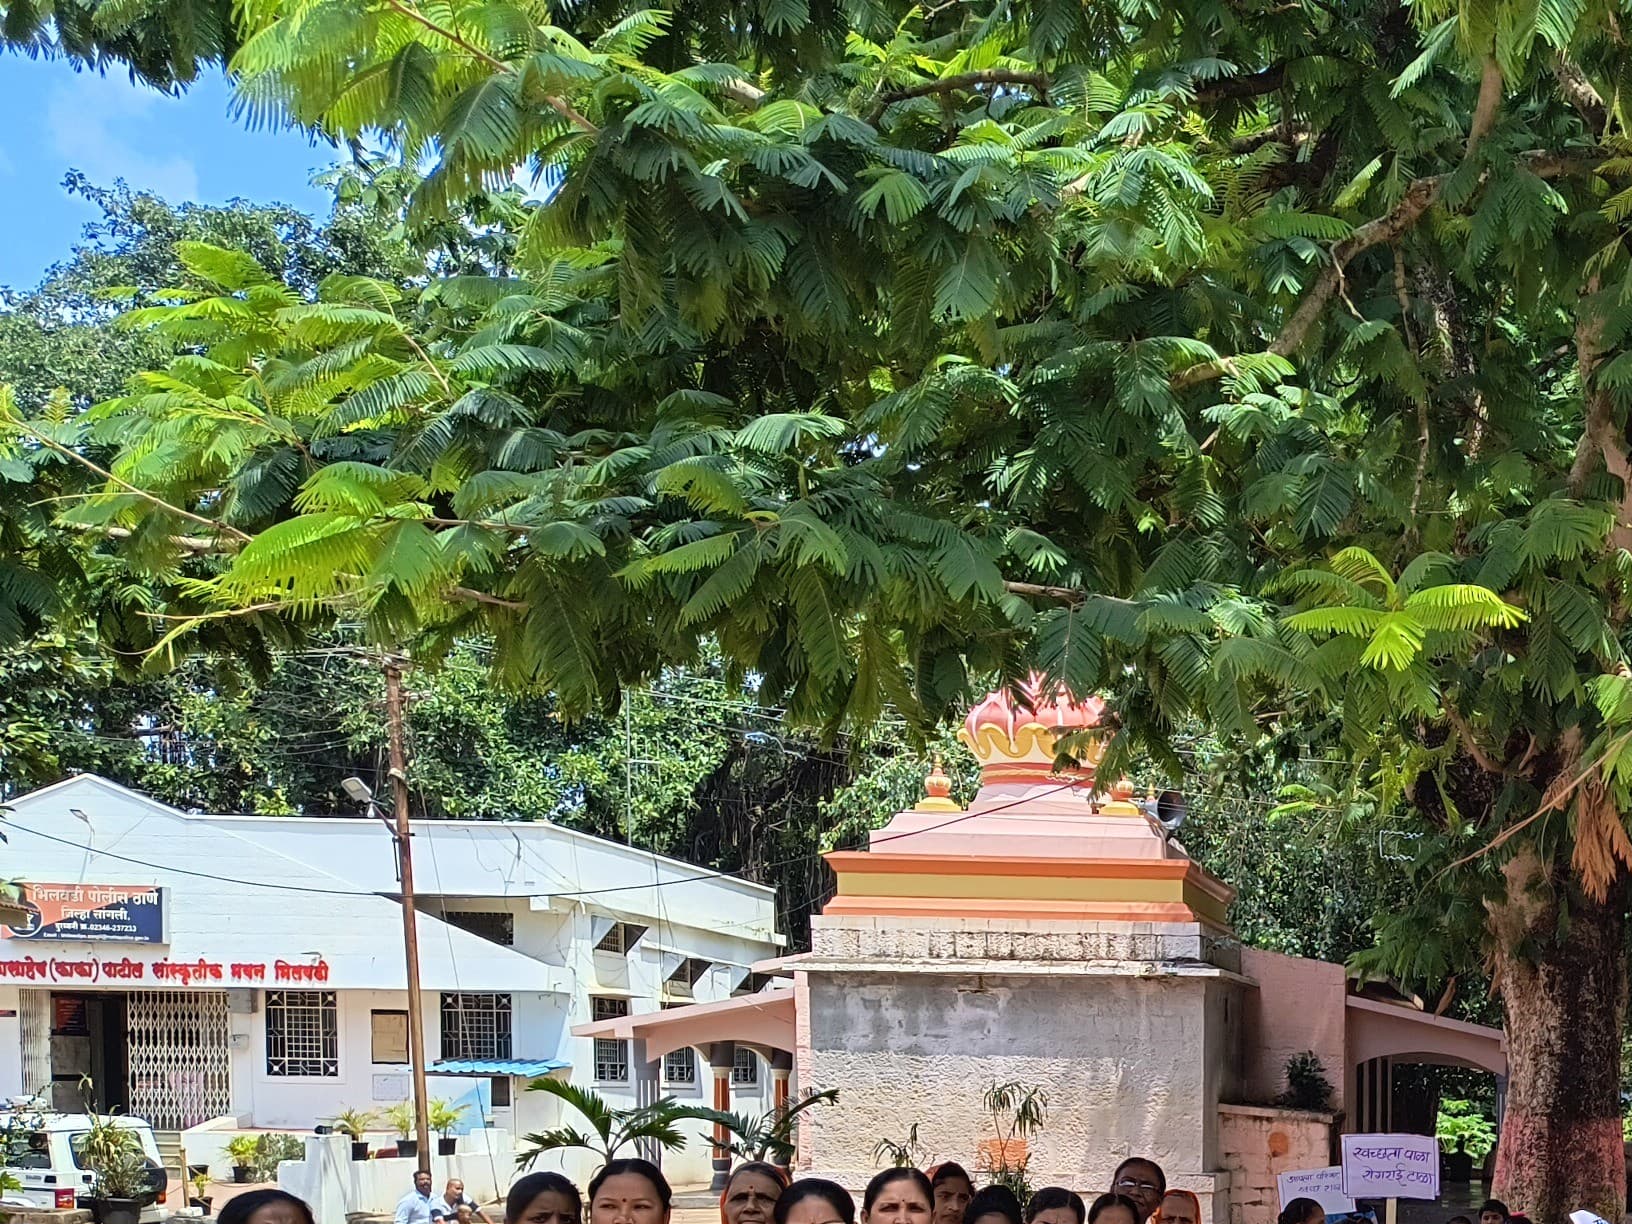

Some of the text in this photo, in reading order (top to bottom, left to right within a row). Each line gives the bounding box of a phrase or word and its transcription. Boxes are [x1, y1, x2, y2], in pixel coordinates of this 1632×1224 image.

[88, 885, 128, 905] पोलीस
[132, 888, 159, 906] ठाणे
[102, 957, 144, 979] पाटील
[1353, 1147, 1432, 1163] स्वच्छता पाळा
[1362, 1163, 1435, 1187] रोगराई टाळा
